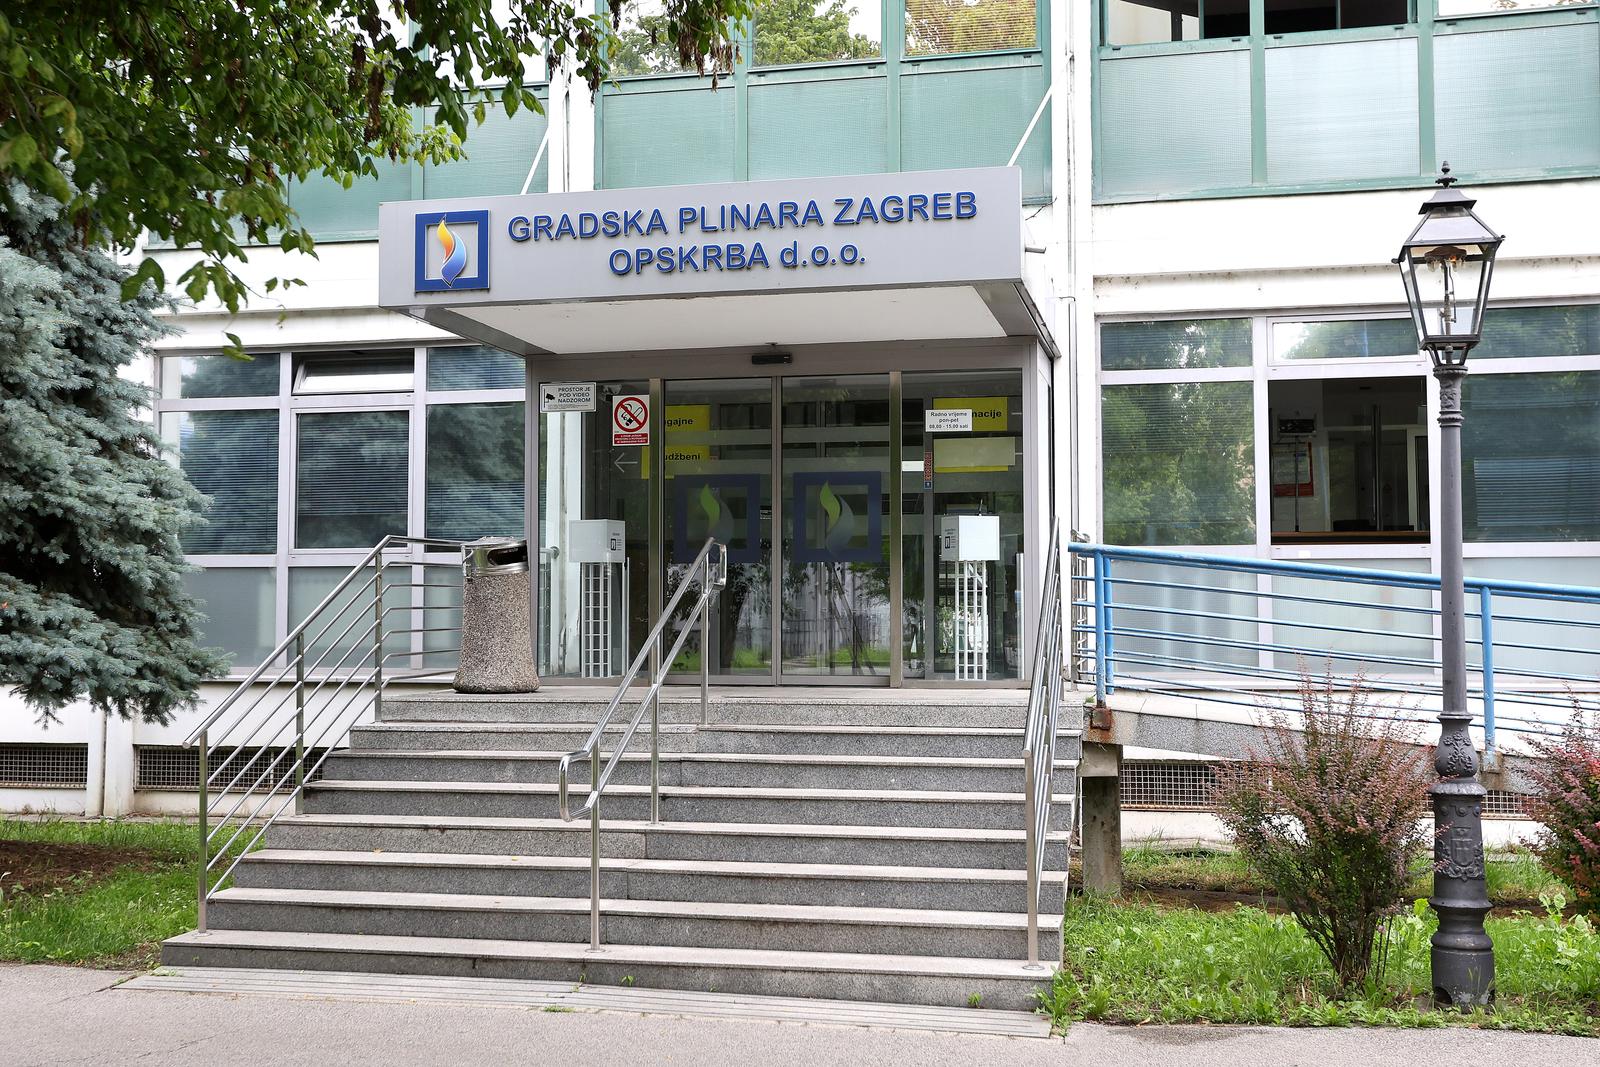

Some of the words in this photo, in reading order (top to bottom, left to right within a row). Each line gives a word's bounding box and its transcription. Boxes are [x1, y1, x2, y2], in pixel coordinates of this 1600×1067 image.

[507, 208, 669, 243] GRADSKA
[678, 199, 825, 233] PLINARA
[832, 190, 979, 226] ZAGREB
[608, 242, 771, 276] OPSKRBA
[778, 240, 867, 268] d.o.o.
[664, 418, 694, 426] gajne
